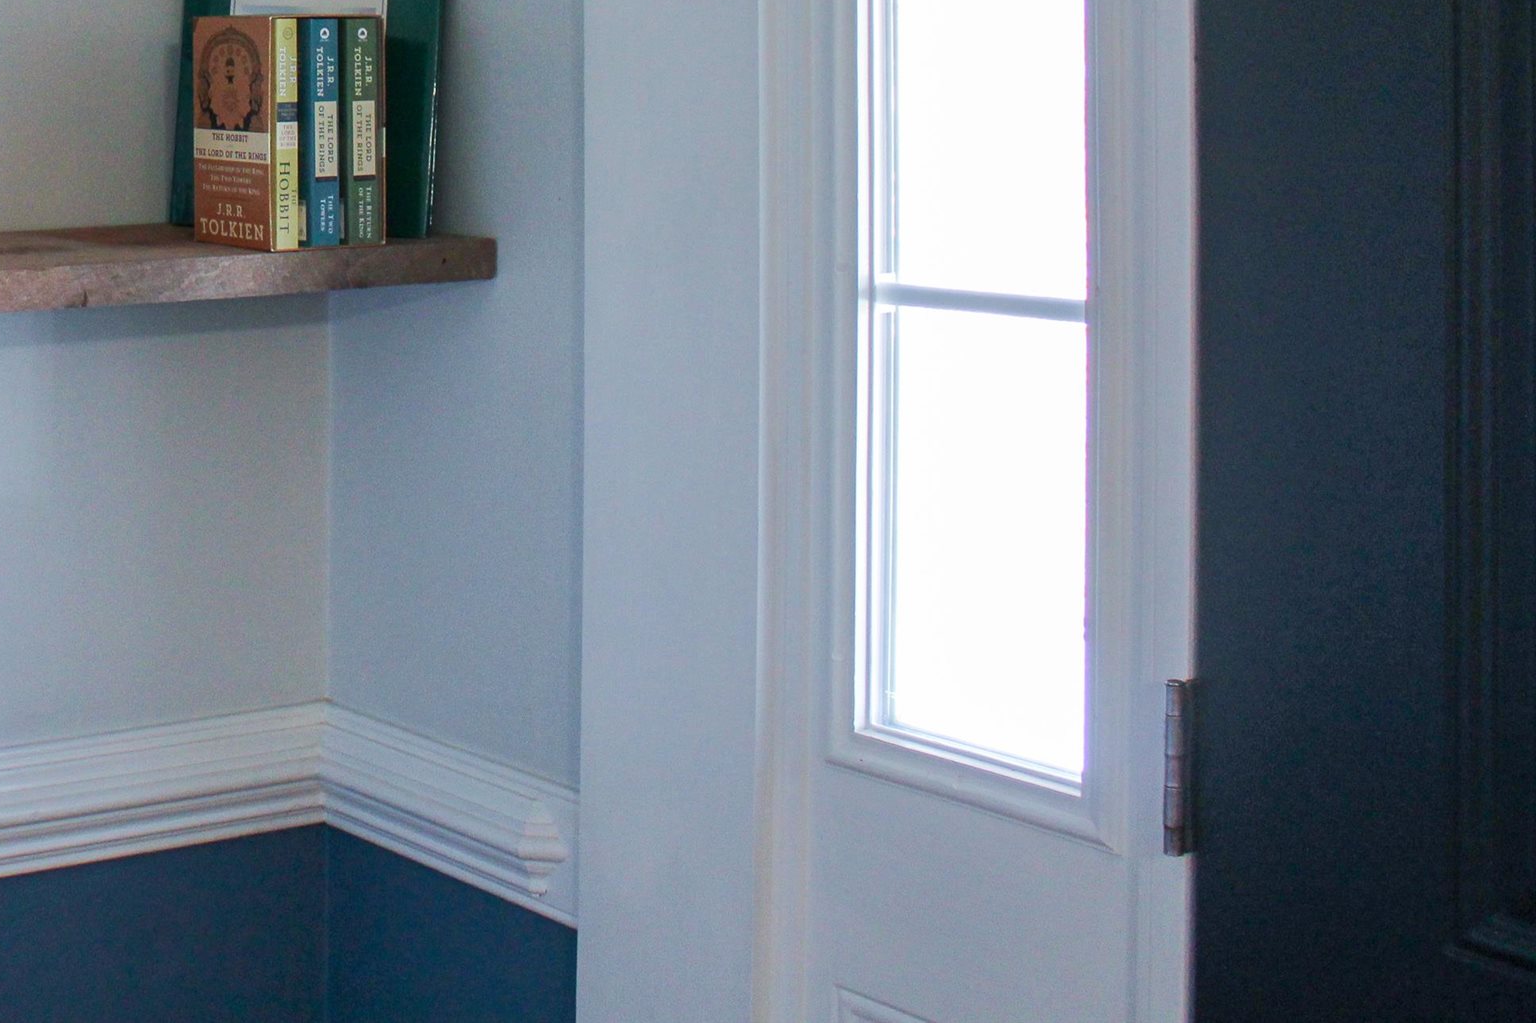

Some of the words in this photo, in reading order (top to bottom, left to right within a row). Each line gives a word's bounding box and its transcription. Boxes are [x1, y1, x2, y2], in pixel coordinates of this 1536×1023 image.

[279, 47, 287, 97] TOLKIEN
[316, 46, 324, 97] TOLKIEN
[327, 56, 335, 87] J.R.R.
[354, 46, 362, 96] TOLKIEN
[364, 56, 372, 86] J.R.R.
[318, 105, 325, 116] OF
[356, 104, 363, 115] OF
[212, 132, 224, 141] THE
[225, 134, 248, 143] HOBBIT
[196, 147, 206, 156] THE
[207, 149, 224, 157] LORD
[225, 150, 233, 158] OF
[235, 151, 247, 159] THE
[248, 152, 267, 161] RINGS
[216, 203, 246, 218] J.R.R.
[279, 162, 290, 234] HOBBIT
[199, 217, 264, 241] TOLKIEN
